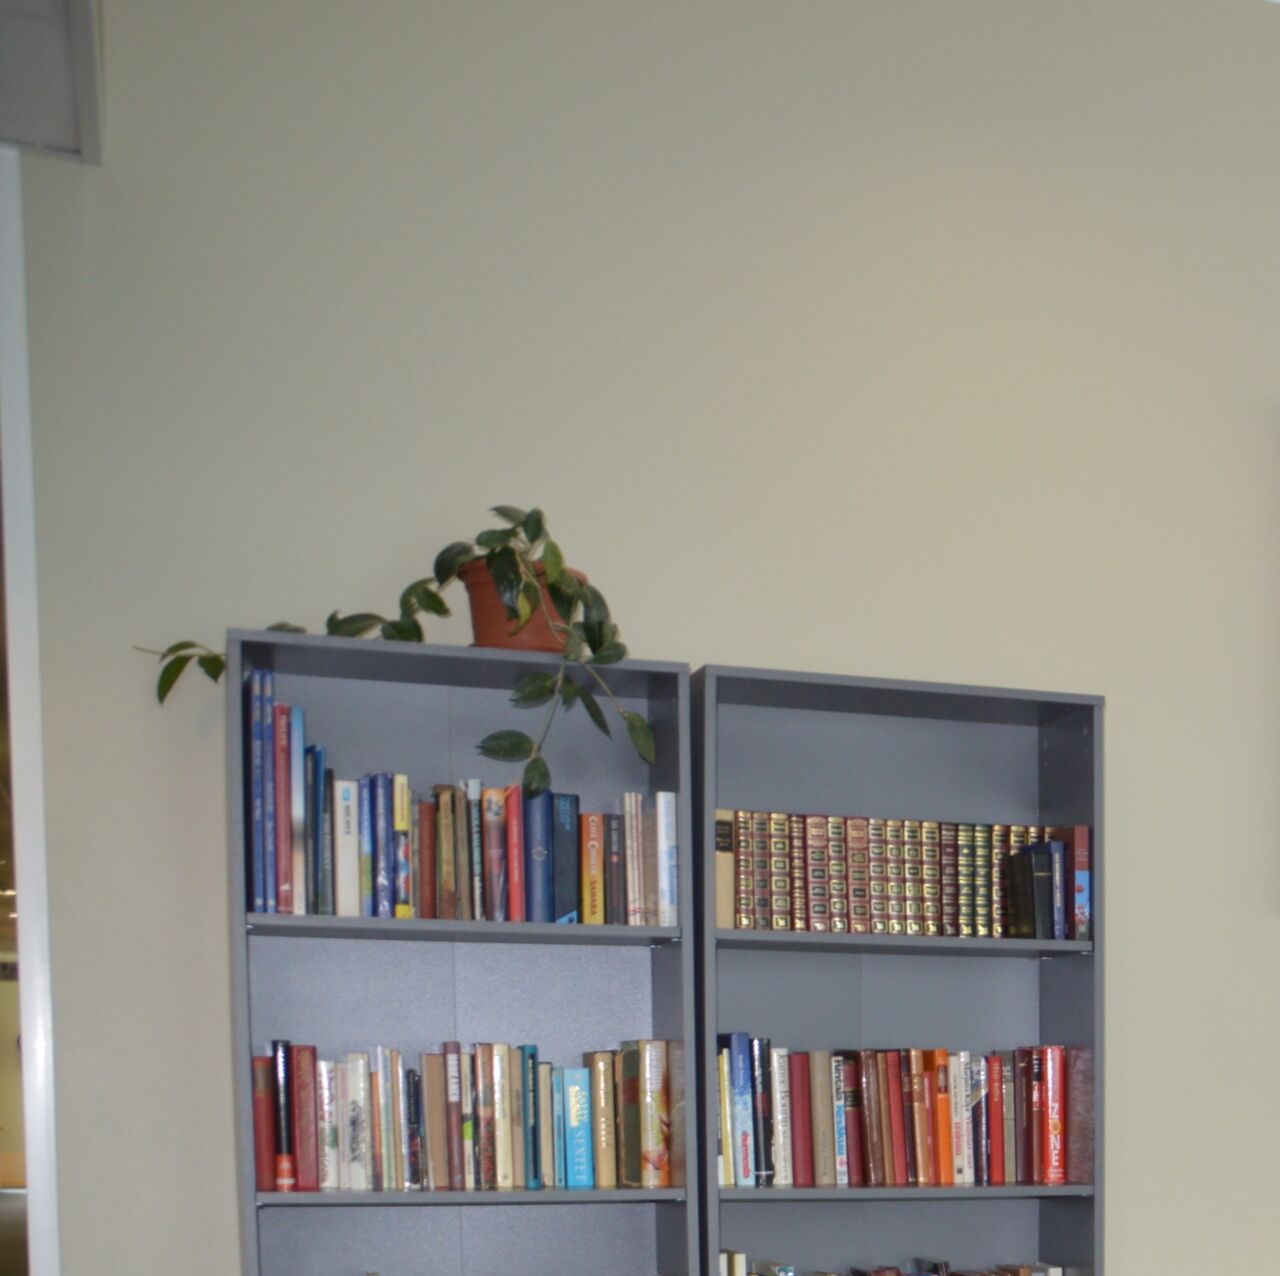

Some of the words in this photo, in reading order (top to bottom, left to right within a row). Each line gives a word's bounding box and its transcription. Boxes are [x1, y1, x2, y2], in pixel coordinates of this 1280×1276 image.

[589, 880, 598, 917] SAHARA
[574, 1131, 587, 1182] SEXTET
[1048, 1103, 1061, 1166] ZONE
